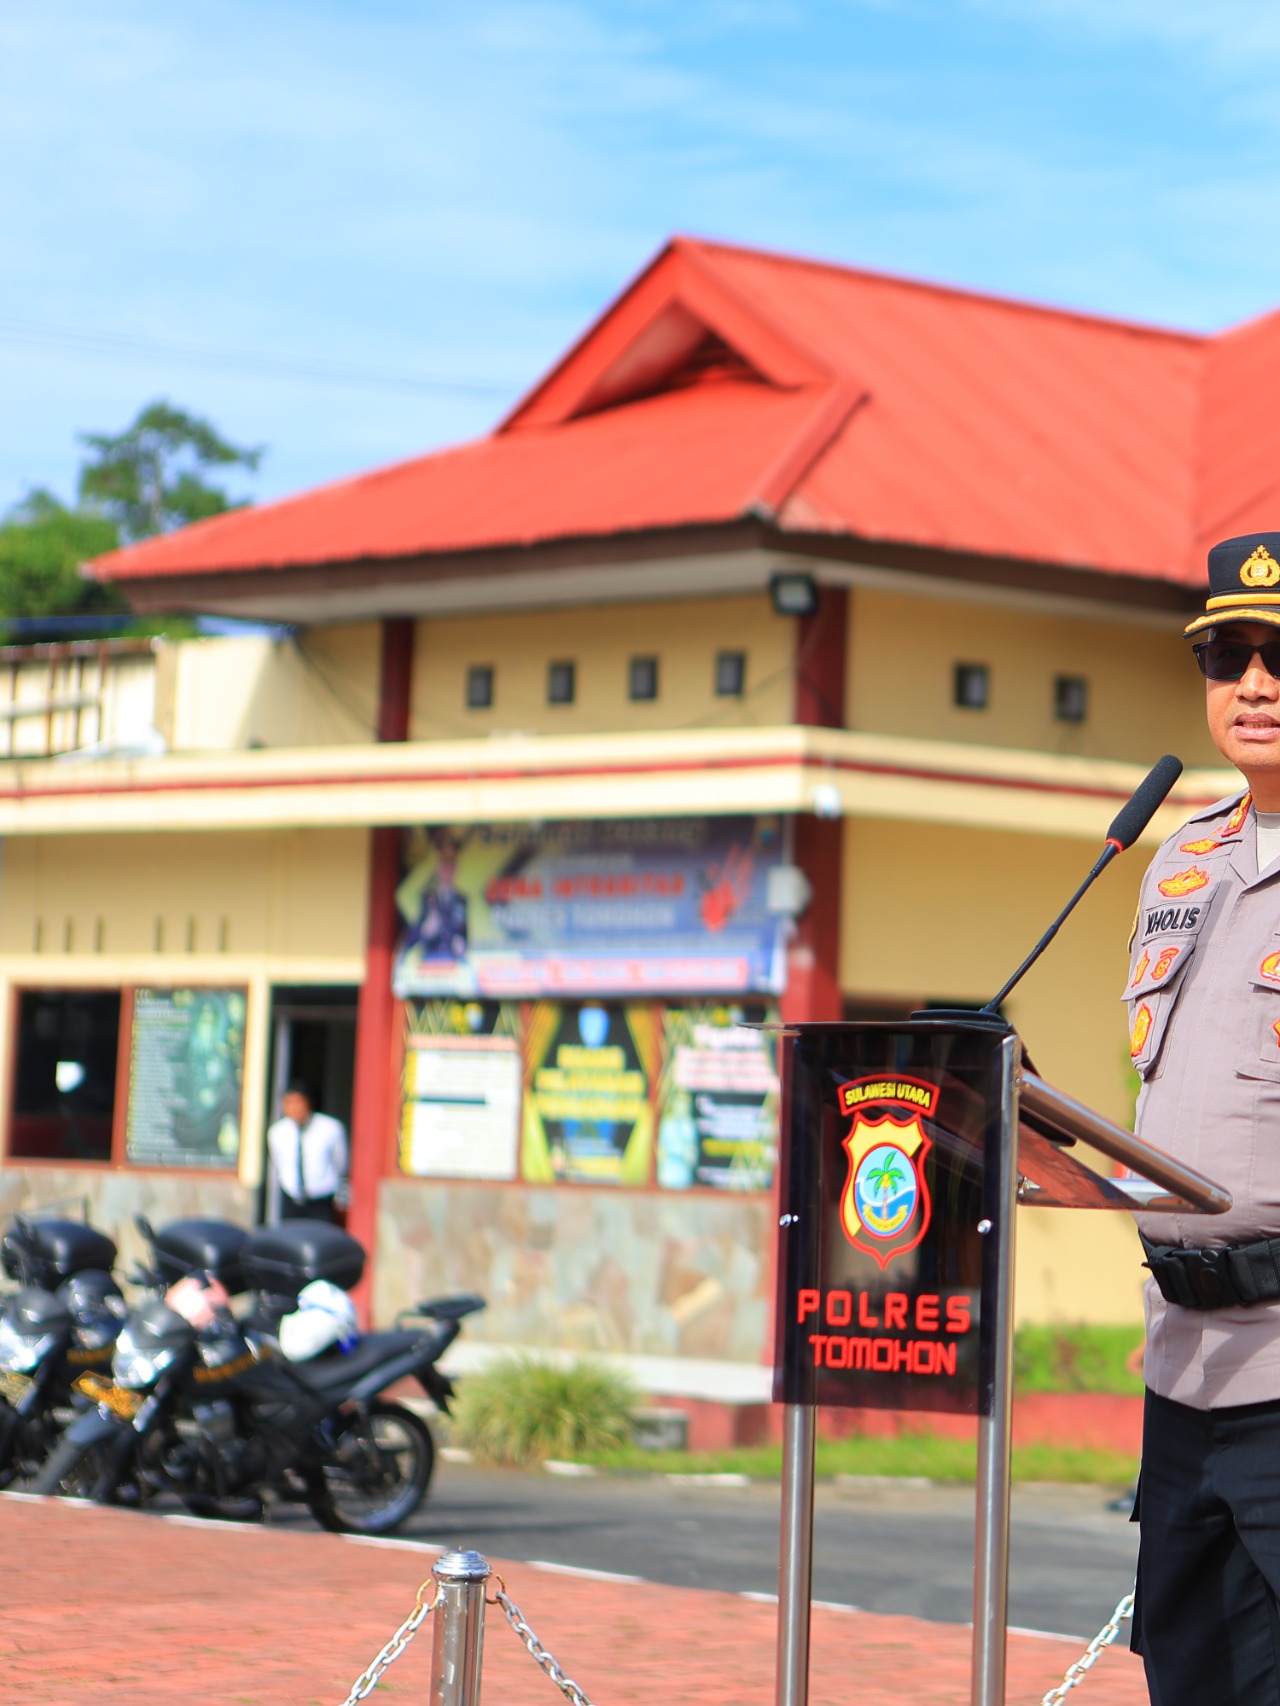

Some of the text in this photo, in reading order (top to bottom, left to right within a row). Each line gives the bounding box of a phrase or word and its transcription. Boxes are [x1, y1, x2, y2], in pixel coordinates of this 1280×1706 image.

[845, 1082, 931, 1108] SULAWESI UTARA
[797, 1288, 972, 1334] POLRES
[808, 1334, 958, 1376] TOMOHON
